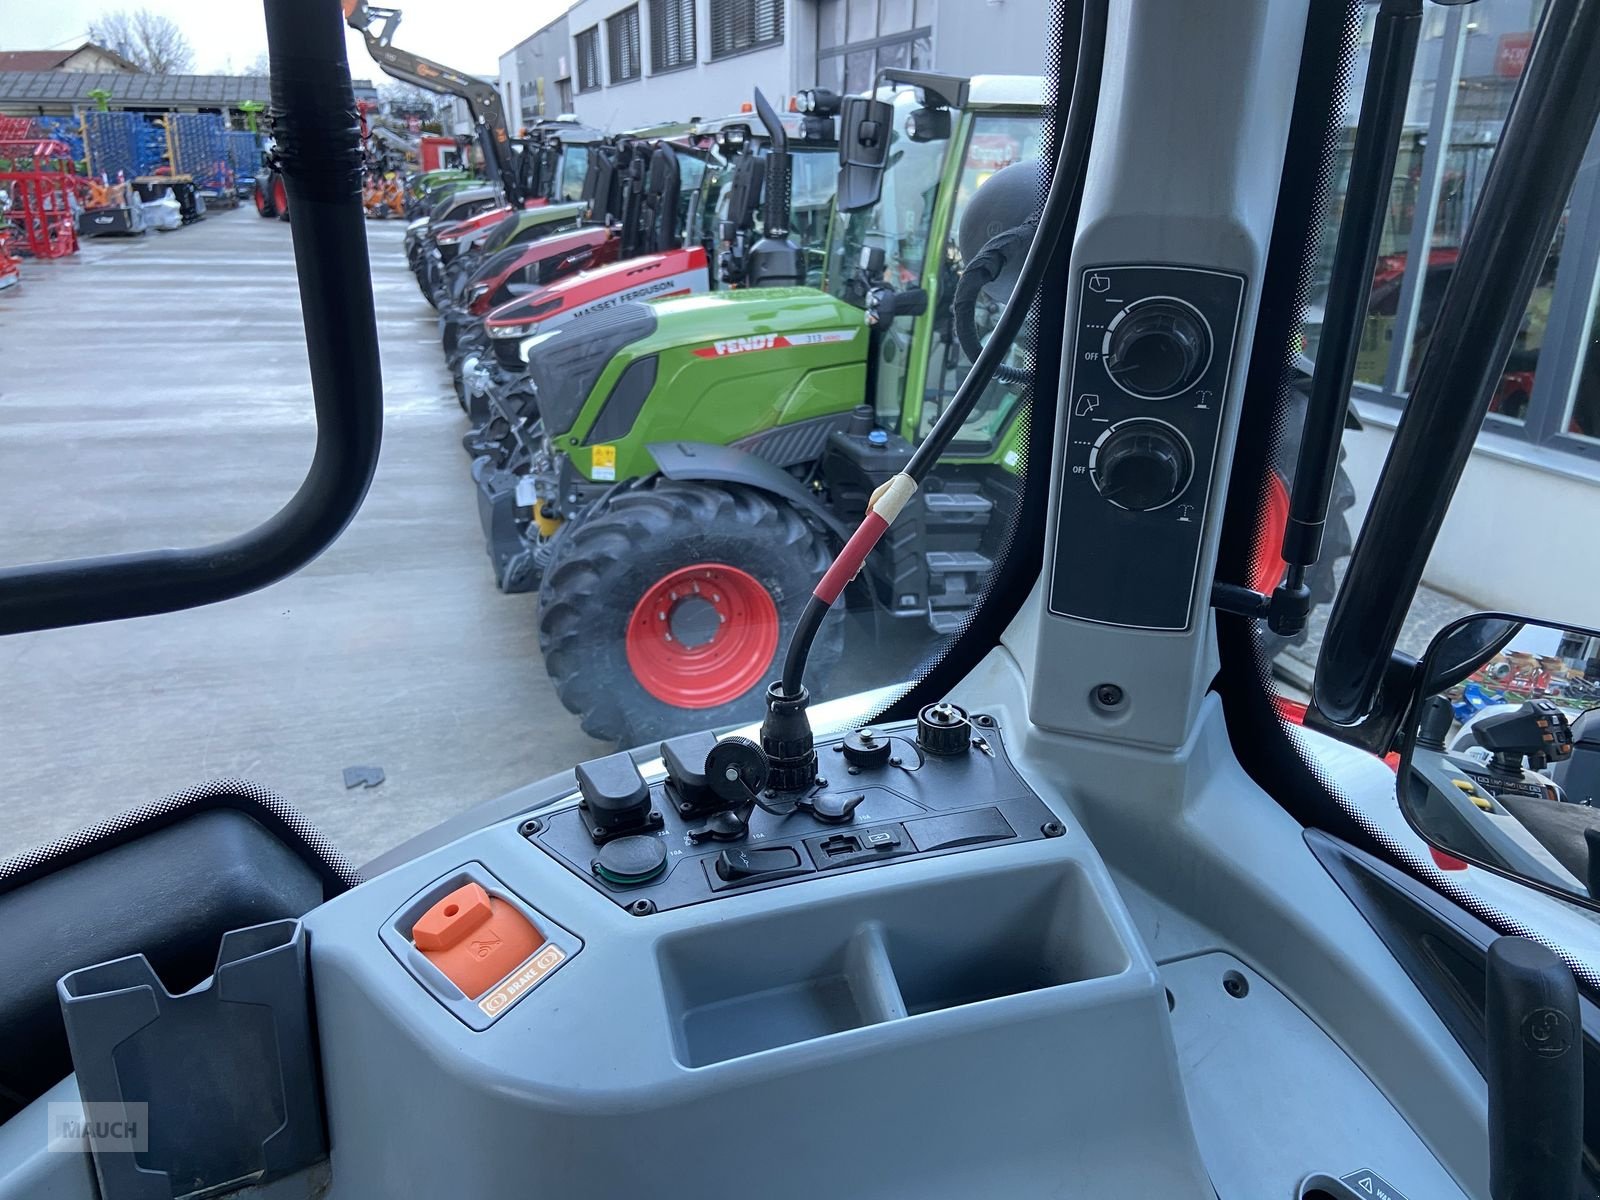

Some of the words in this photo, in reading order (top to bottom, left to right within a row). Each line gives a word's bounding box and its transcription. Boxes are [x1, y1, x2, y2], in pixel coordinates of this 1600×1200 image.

[620, 280, 675, 303] FERGUSON
[713, 333, 778, 355] FENDT
[1084, 352, 1099, 361] OFF
[1072, 465, 1086, 474] OFF
[752, 832, 765, 840] 10A
[670, 849, 683, 857] 10A
[506, 967, 538, 995] BRAKE
